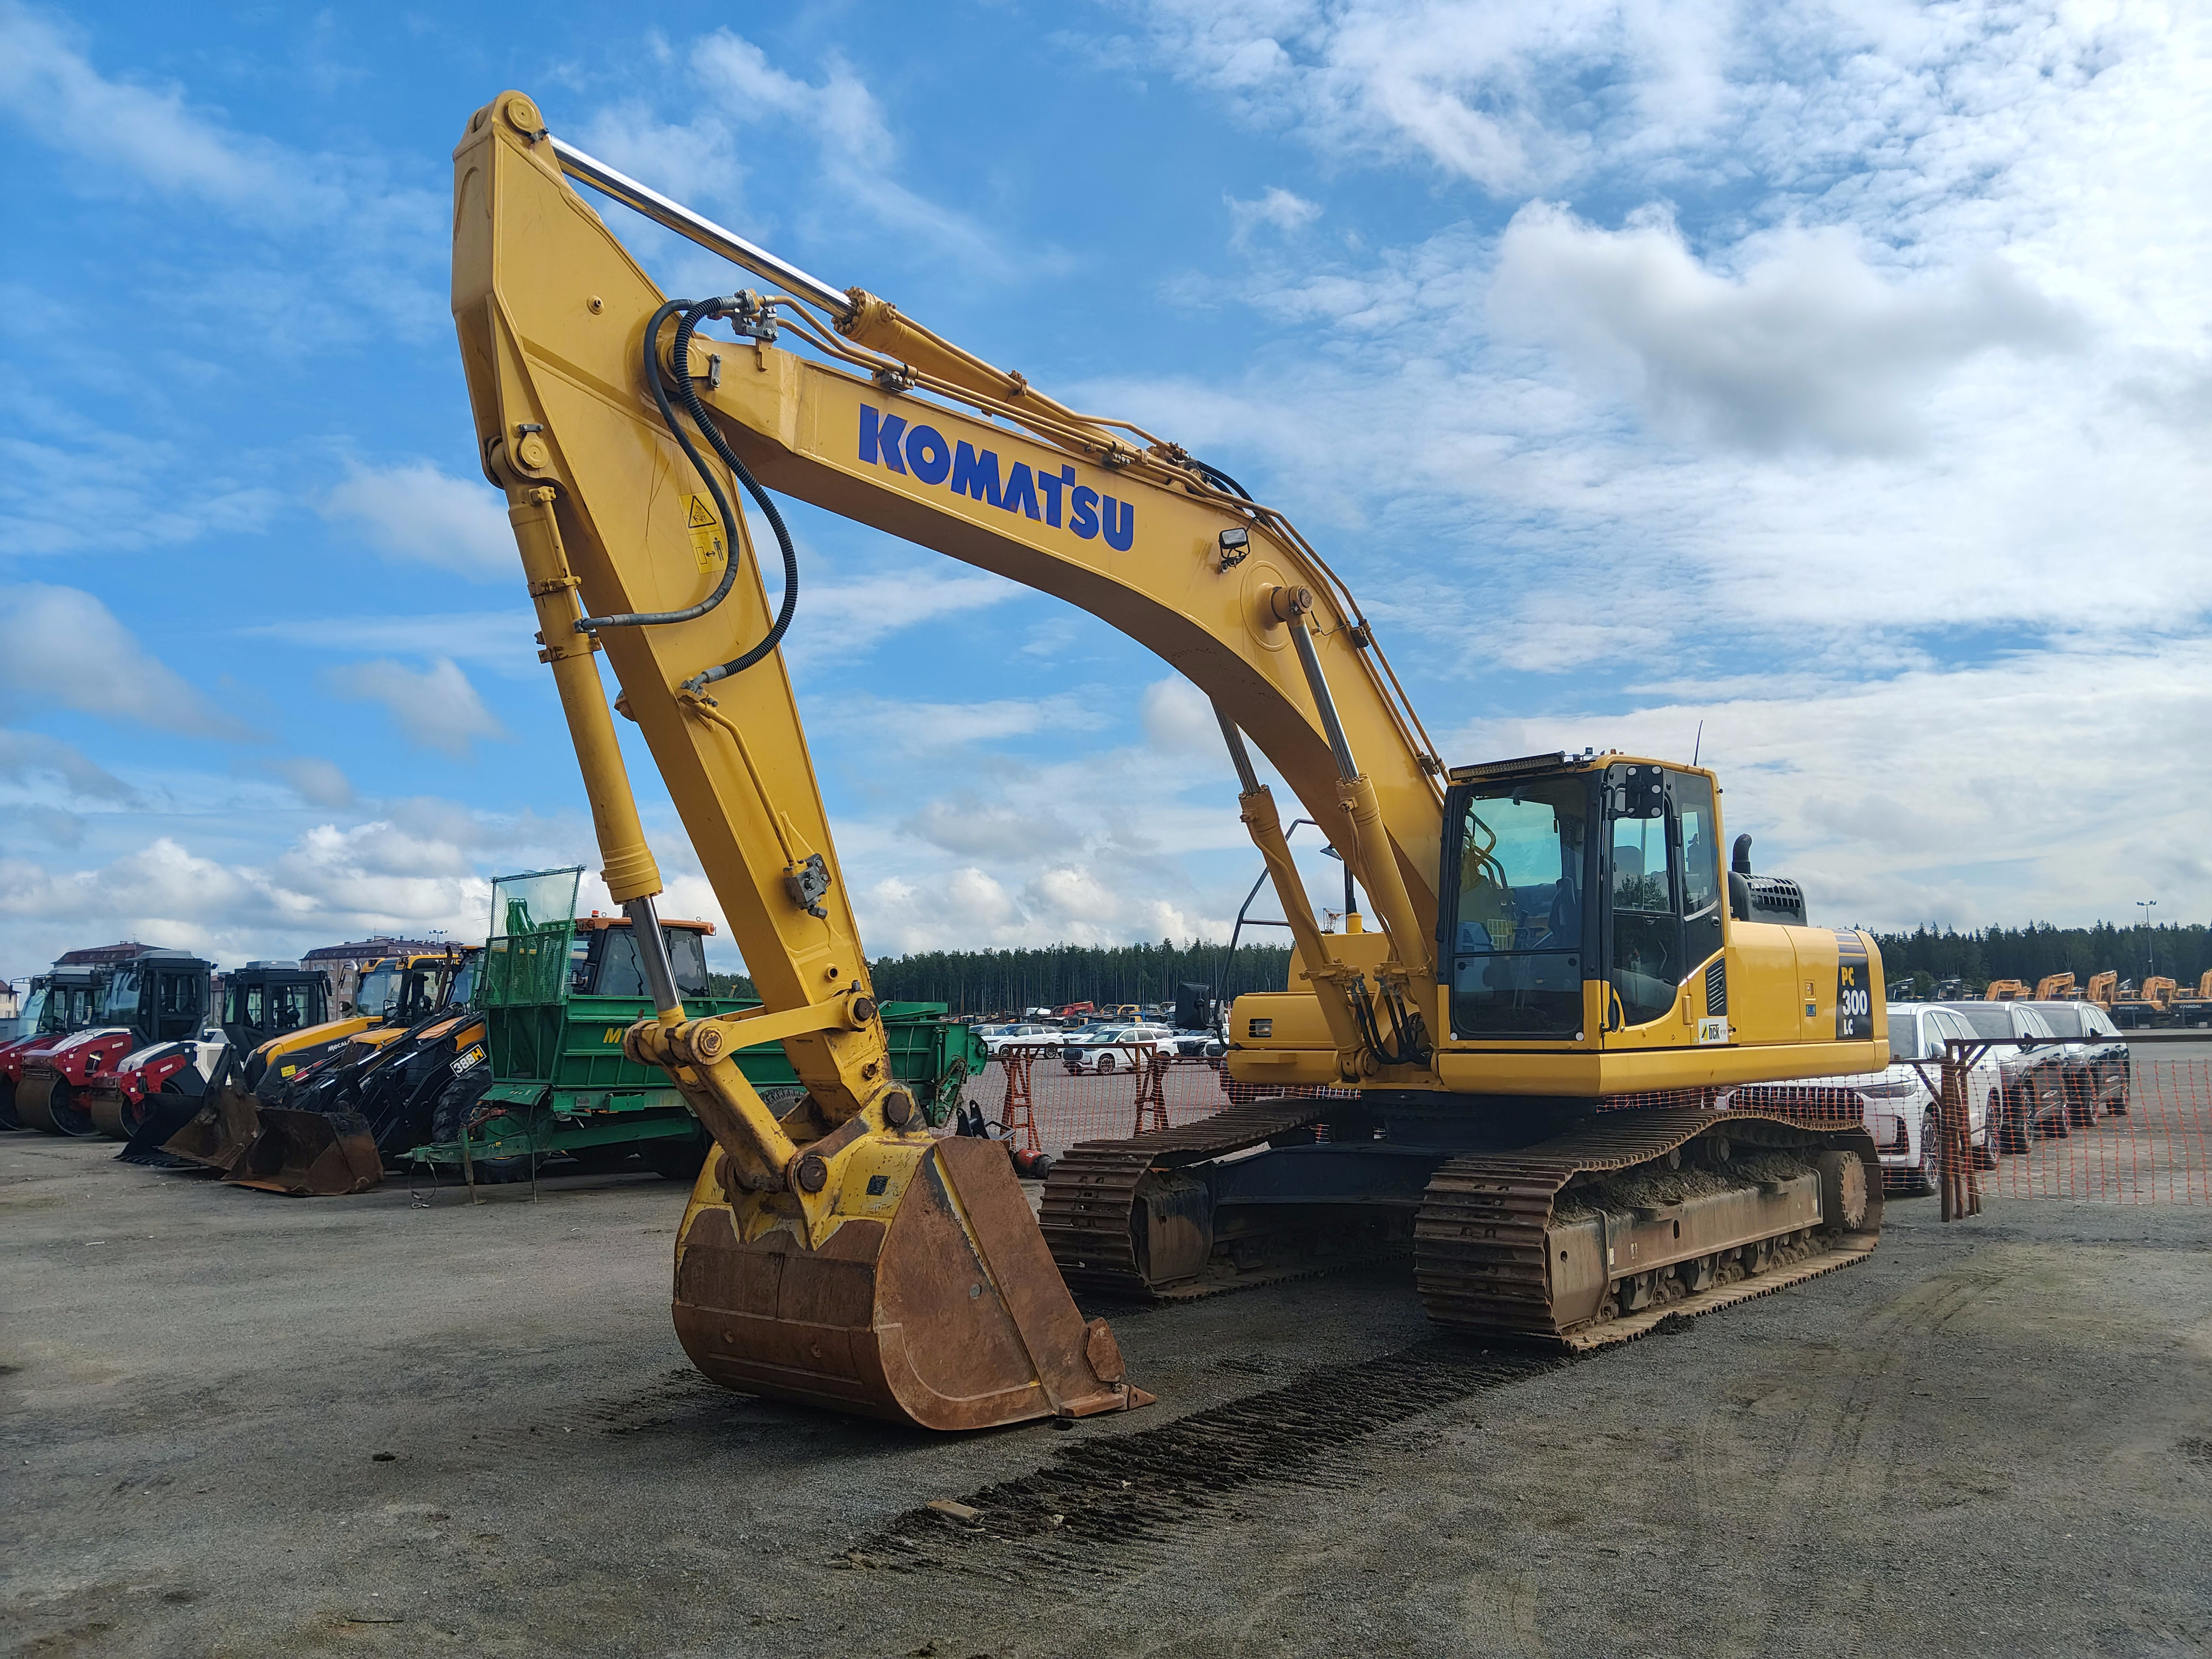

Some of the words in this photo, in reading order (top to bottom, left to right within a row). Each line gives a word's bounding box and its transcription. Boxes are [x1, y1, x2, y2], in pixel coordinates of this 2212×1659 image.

[859, 403, 1134, 552] KOMATSU
[1841, 967, 1854, 986] PC
[1842, 990, 1867, 1015] 300
[1843, 1019, 1853, 1035] LC
[453, 1048, 484, 1074] 388H
